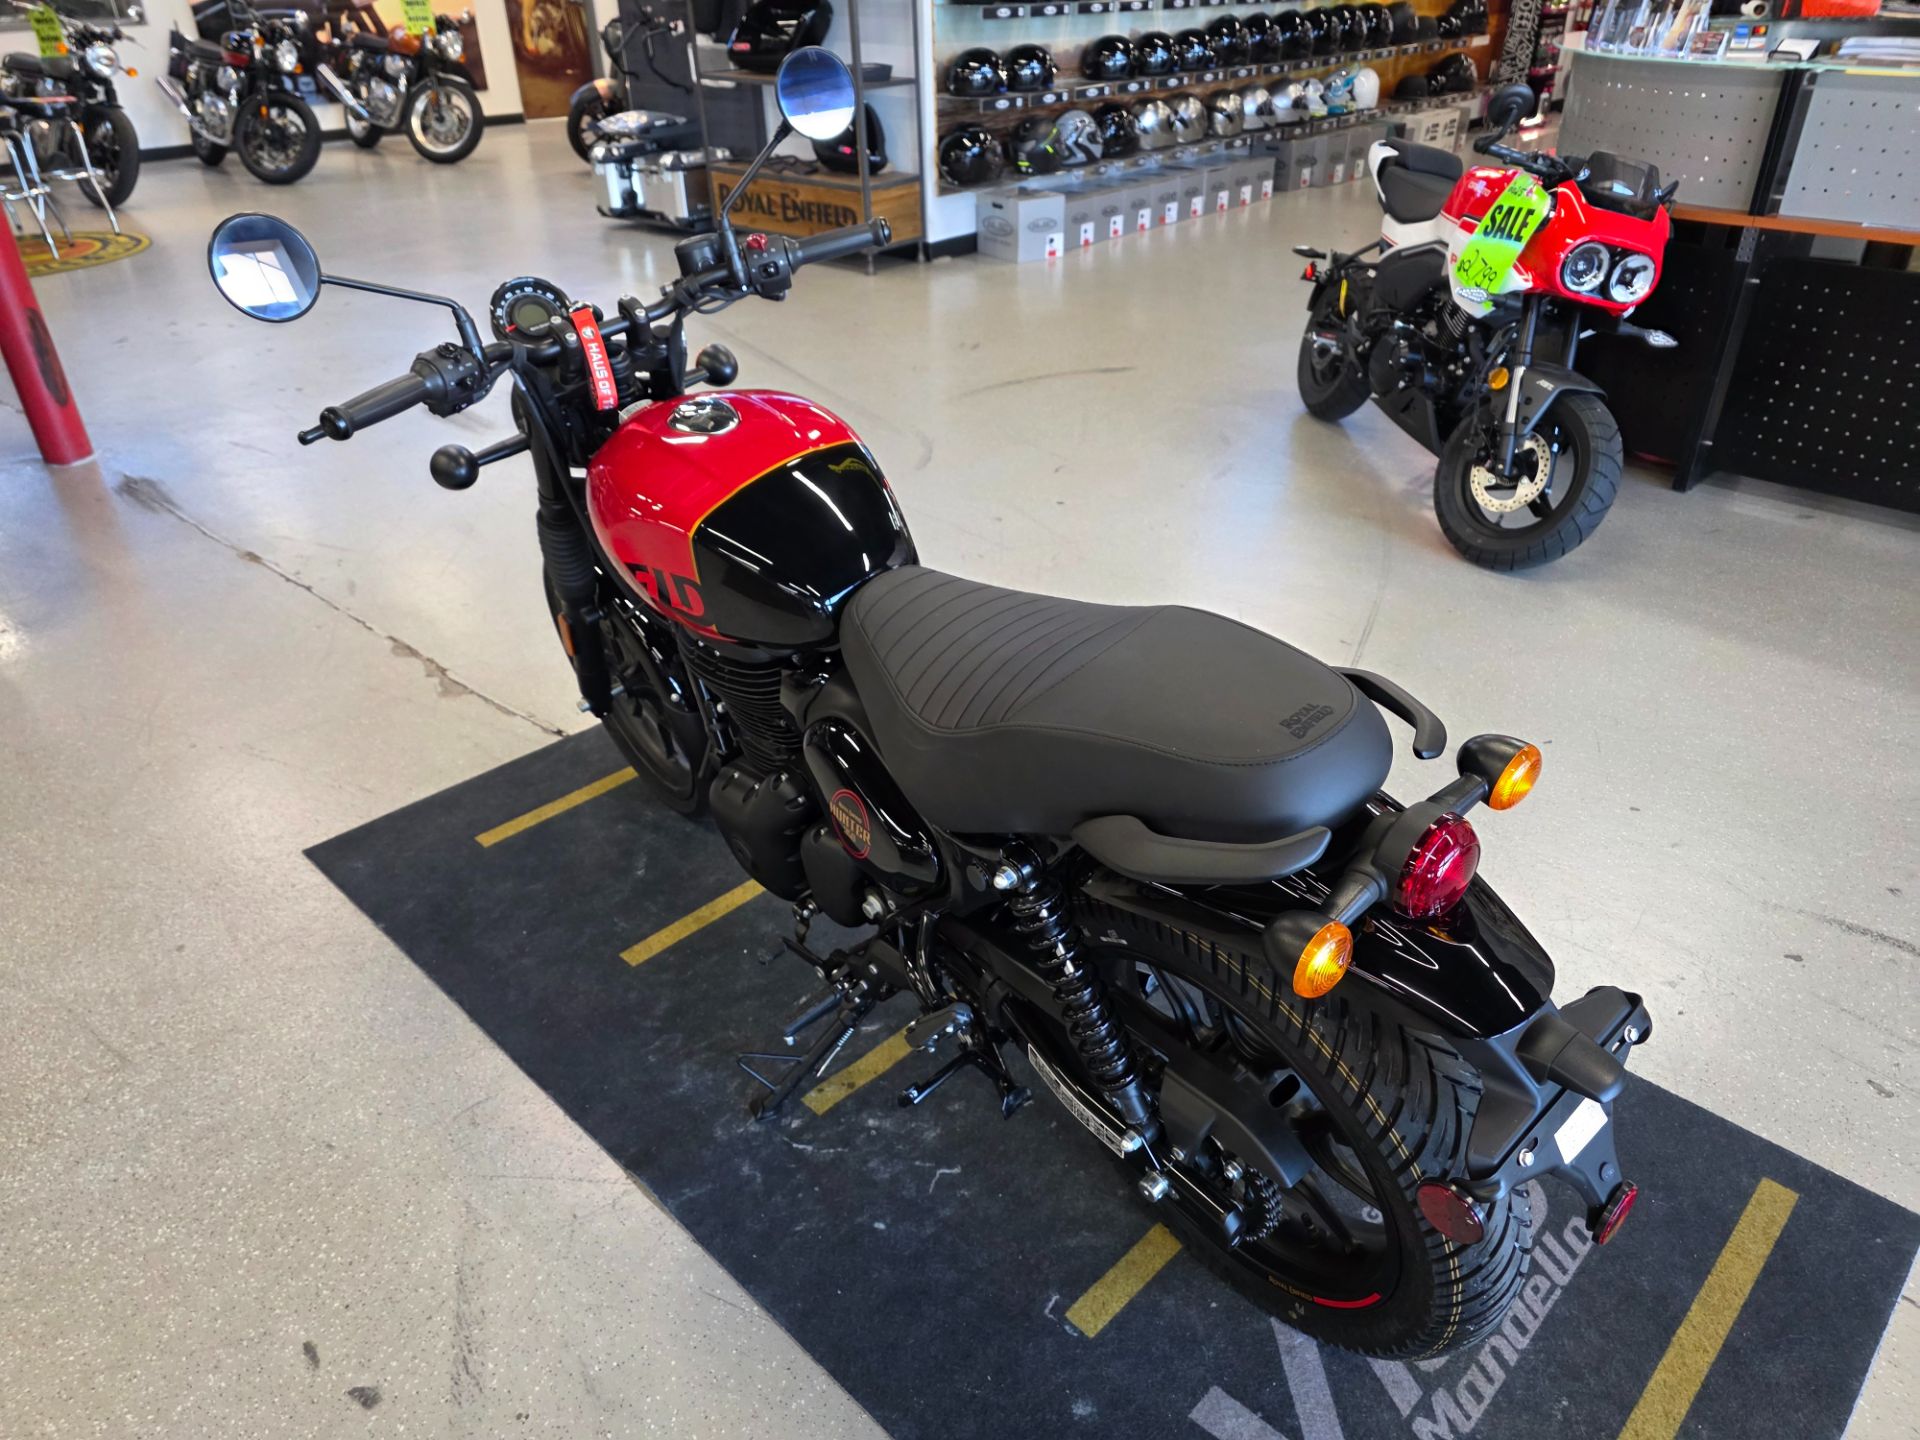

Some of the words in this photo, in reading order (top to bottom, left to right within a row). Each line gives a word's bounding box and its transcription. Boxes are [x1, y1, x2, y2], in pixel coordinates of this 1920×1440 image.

[718, 183, 776, 216] ROYAL
[780, 191, 858, 227] ENFIELD
[1483, 204, 1536, 243] SALE
[588, 343, 609, 379] HAUS
[599, 380, 612, 396] OF
[829, 800, 872, 846] HUNTER
[1412, 1216, 1594, 1440] Mandello
